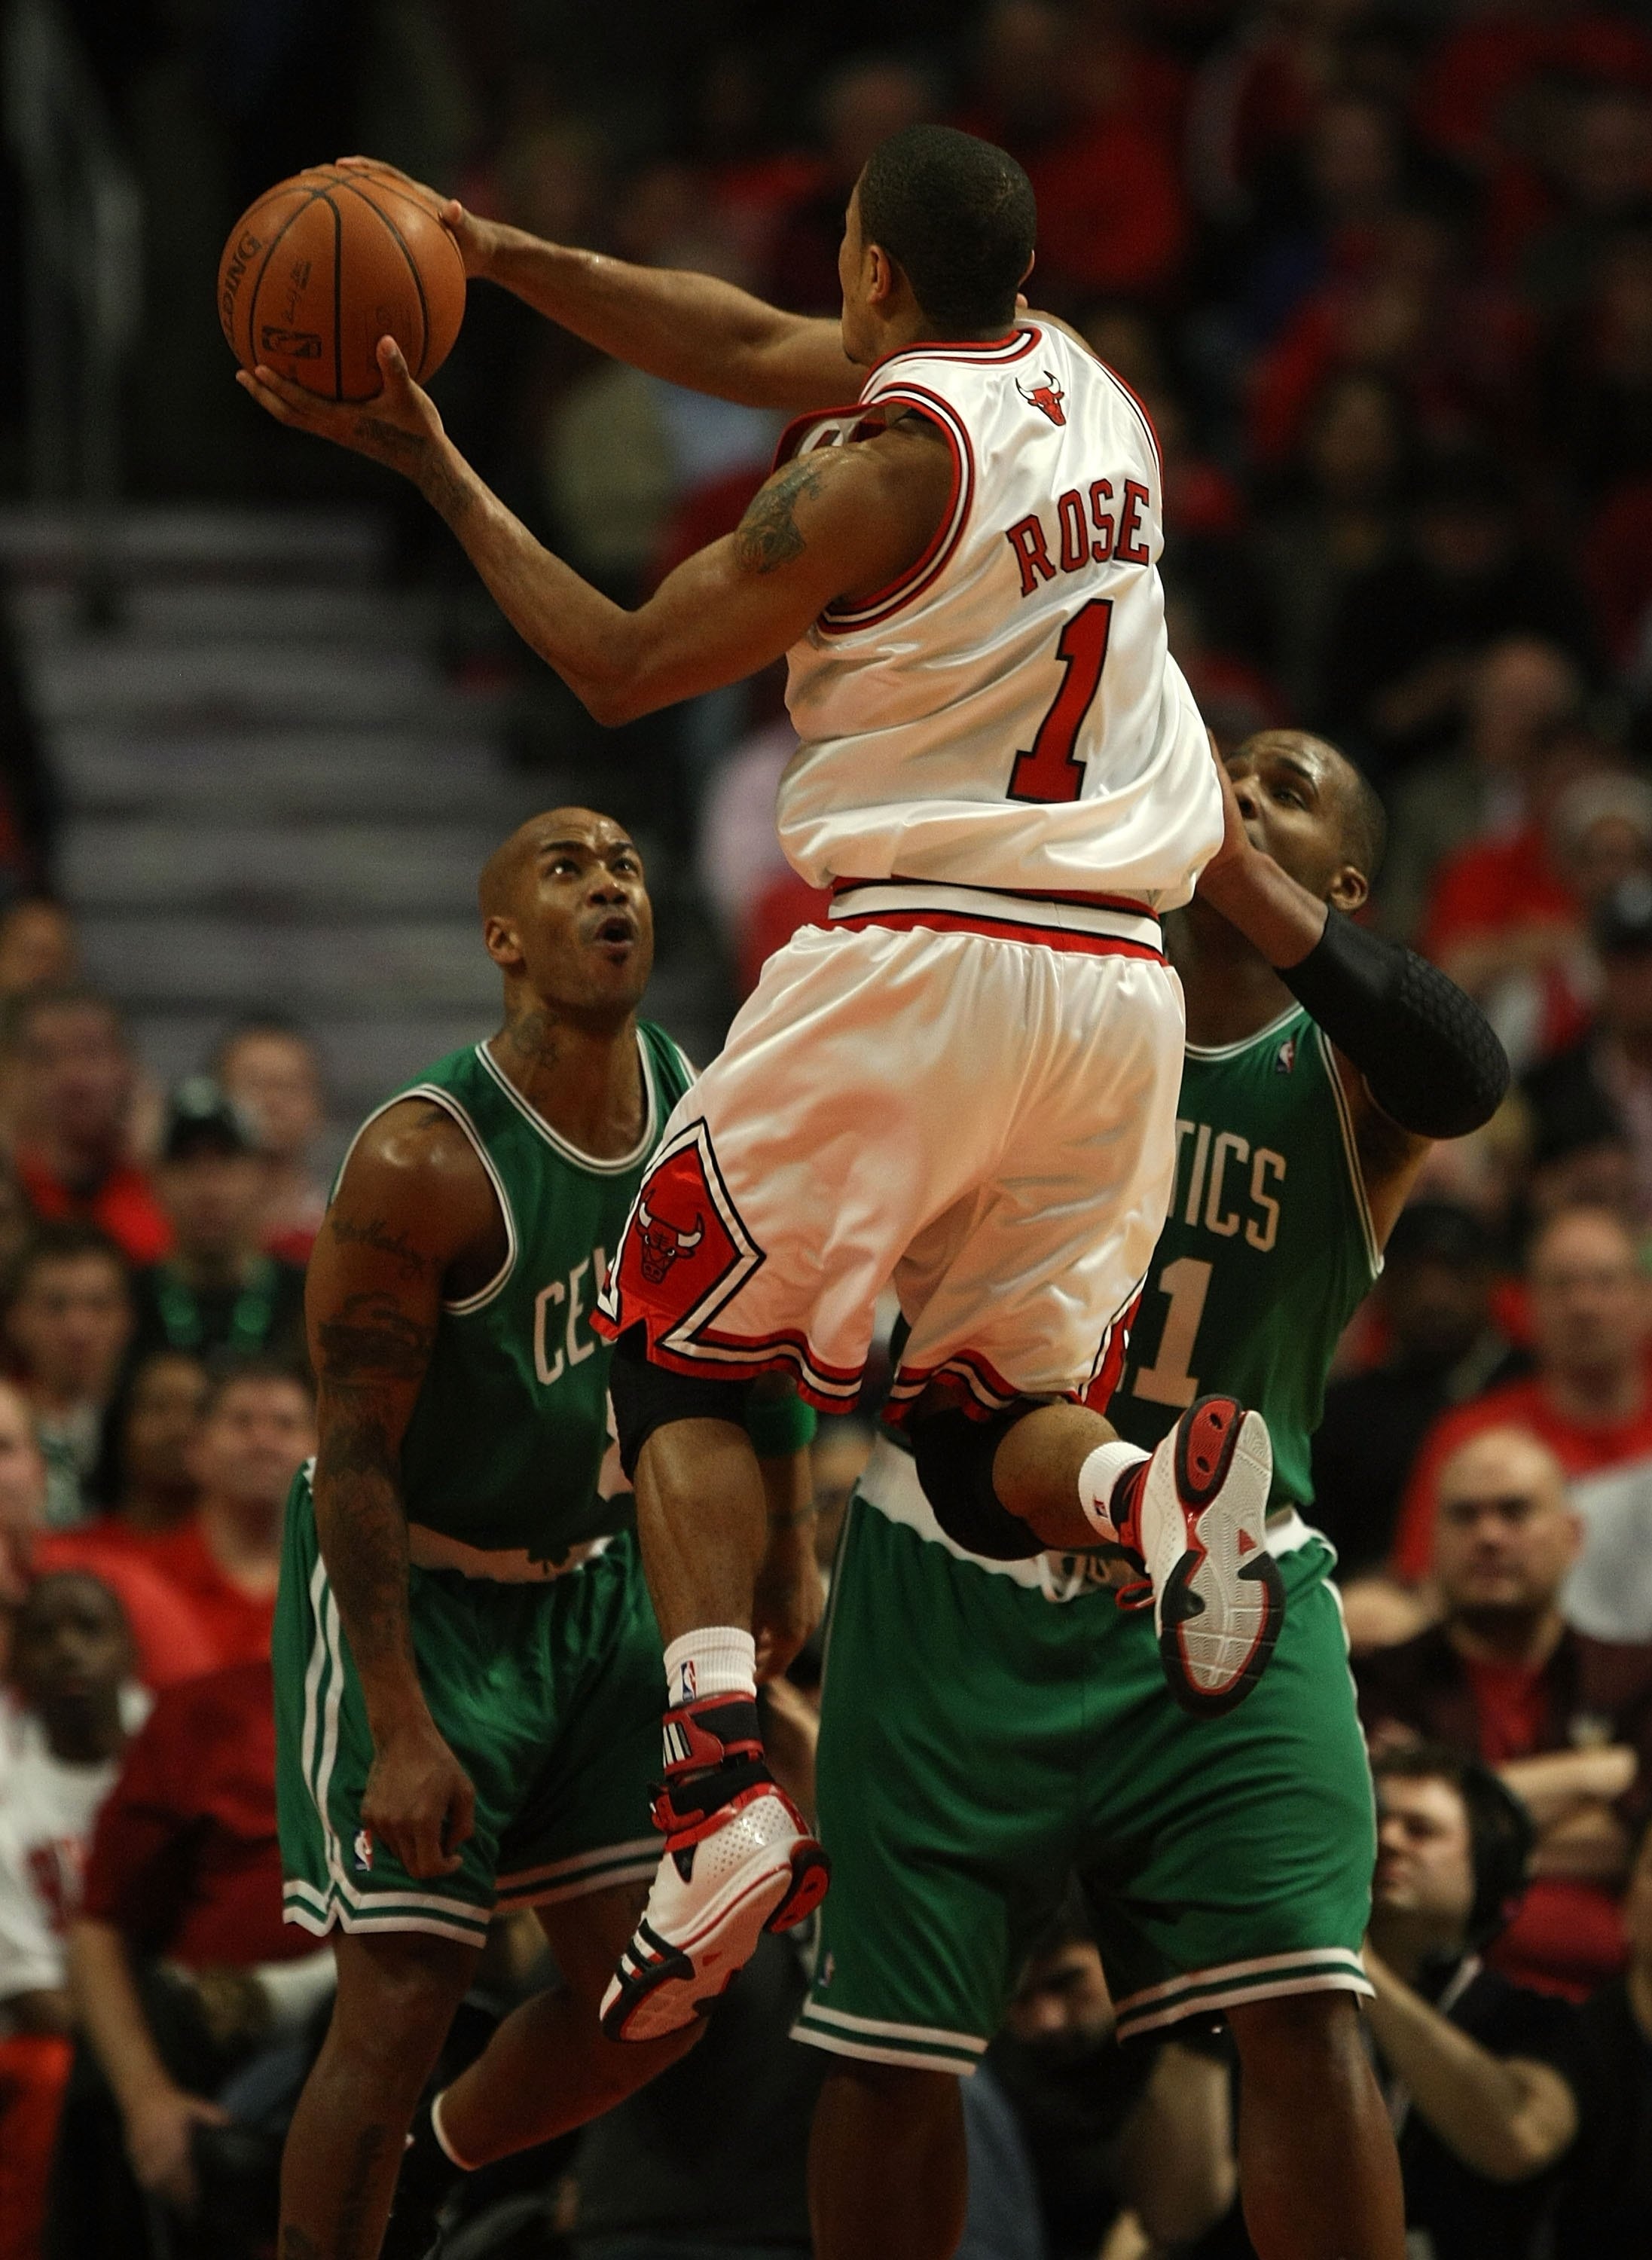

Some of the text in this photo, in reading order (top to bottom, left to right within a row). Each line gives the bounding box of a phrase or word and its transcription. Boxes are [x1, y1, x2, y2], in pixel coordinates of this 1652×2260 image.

[1006, 478, 1150, 597] ROSE
[1006, 598, 1113, 804] 1
[1116, 1257, 1213, 1408] 1
